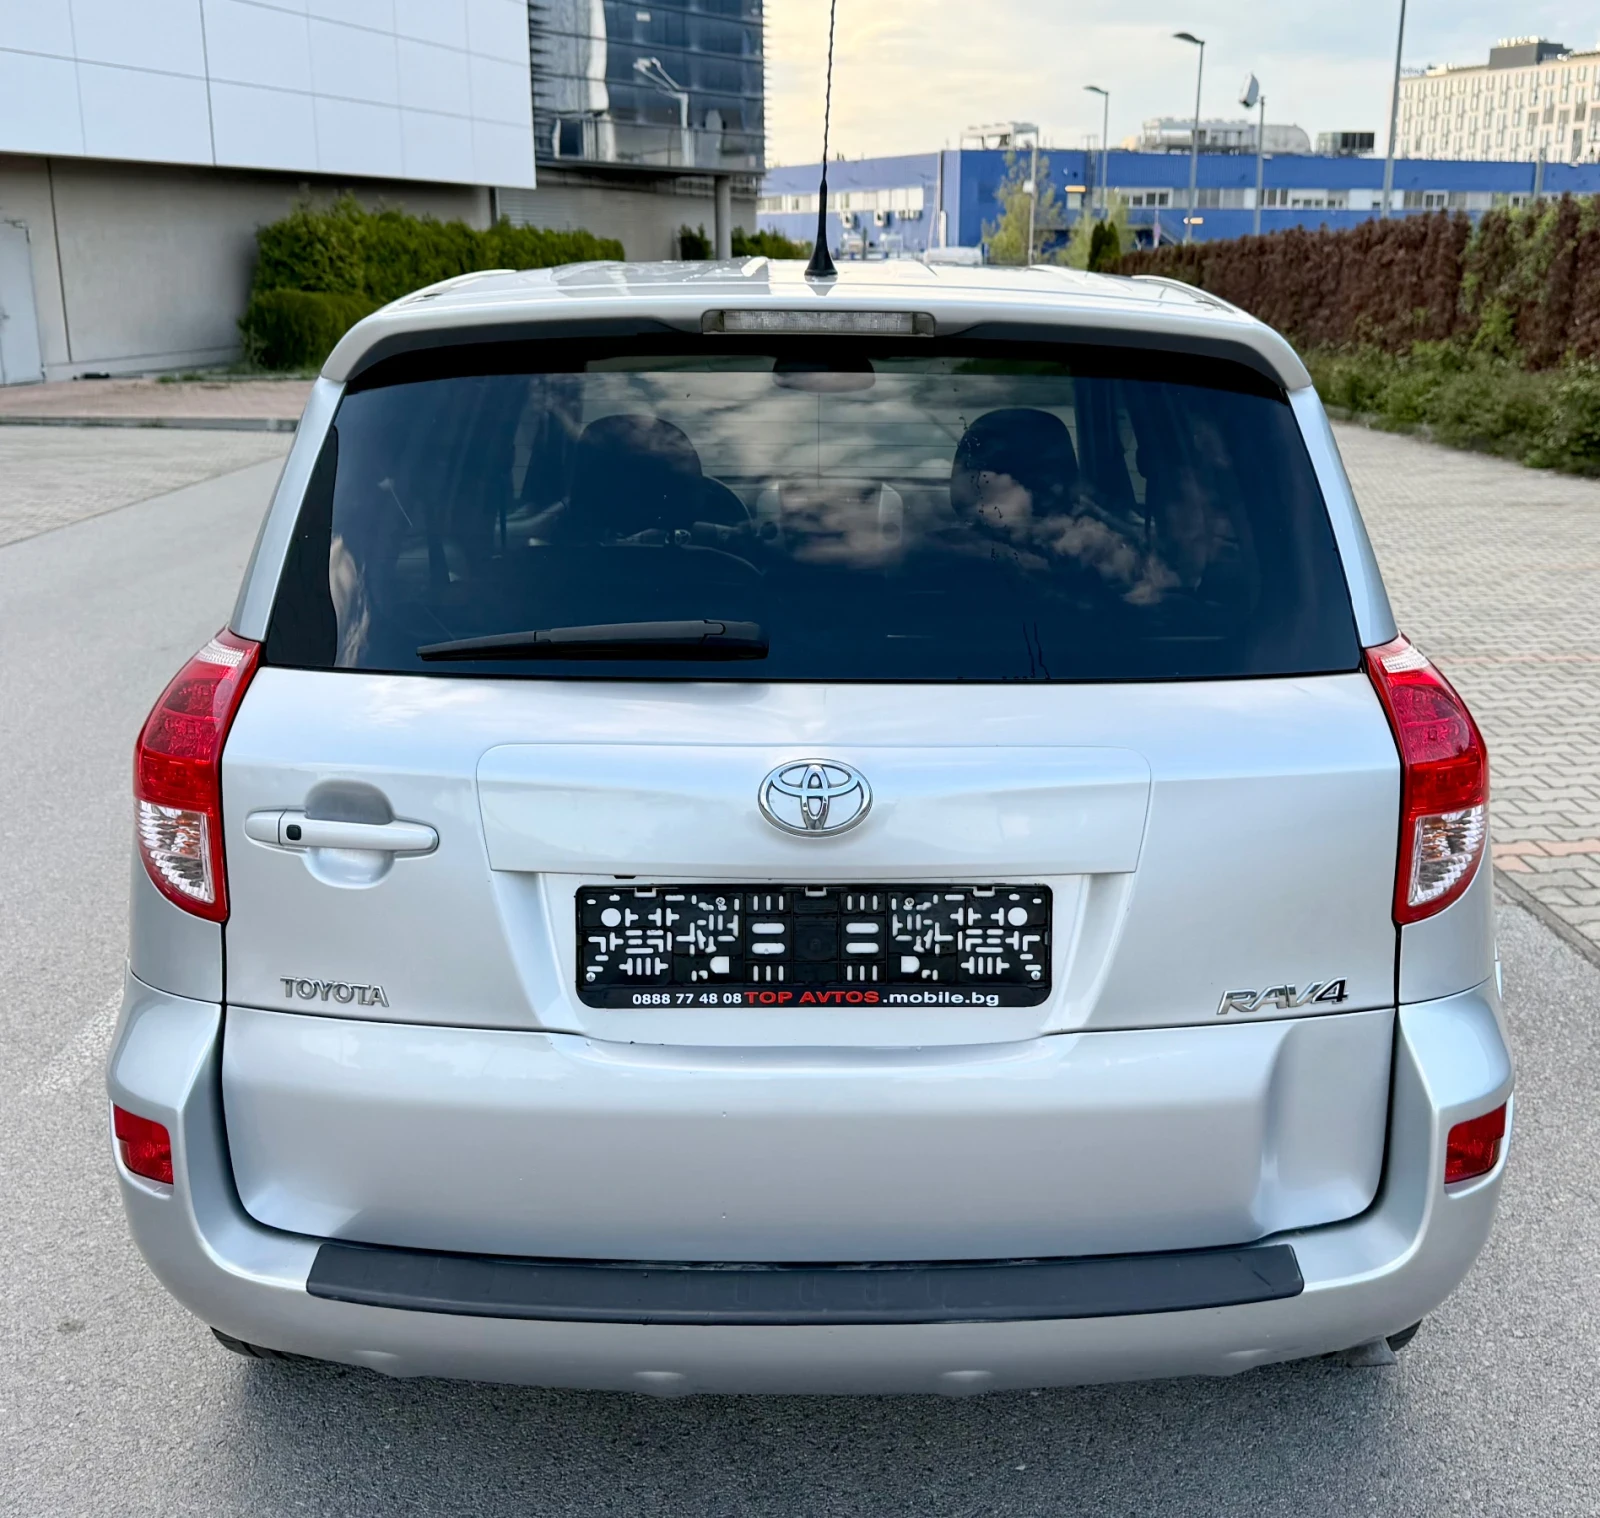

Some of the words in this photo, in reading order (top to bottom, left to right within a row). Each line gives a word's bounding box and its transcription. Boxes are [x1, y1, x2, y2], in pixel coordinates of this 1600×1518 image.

[280, 976, 389, 1007] TOYOTA
[632, 993, 671, 1005] 0888
[675, 993, 694, 1005] 77
[698, 993, 718, 1004] 48
[723, 993, 742, 1004] 08
[744, 991, 792, 1004] TOP
[799, 990, 880, 1004] AVTOS
[882, 991, 999, 1007] .mobile.bg
[1217, 977, 1349, 1015] RAV4
